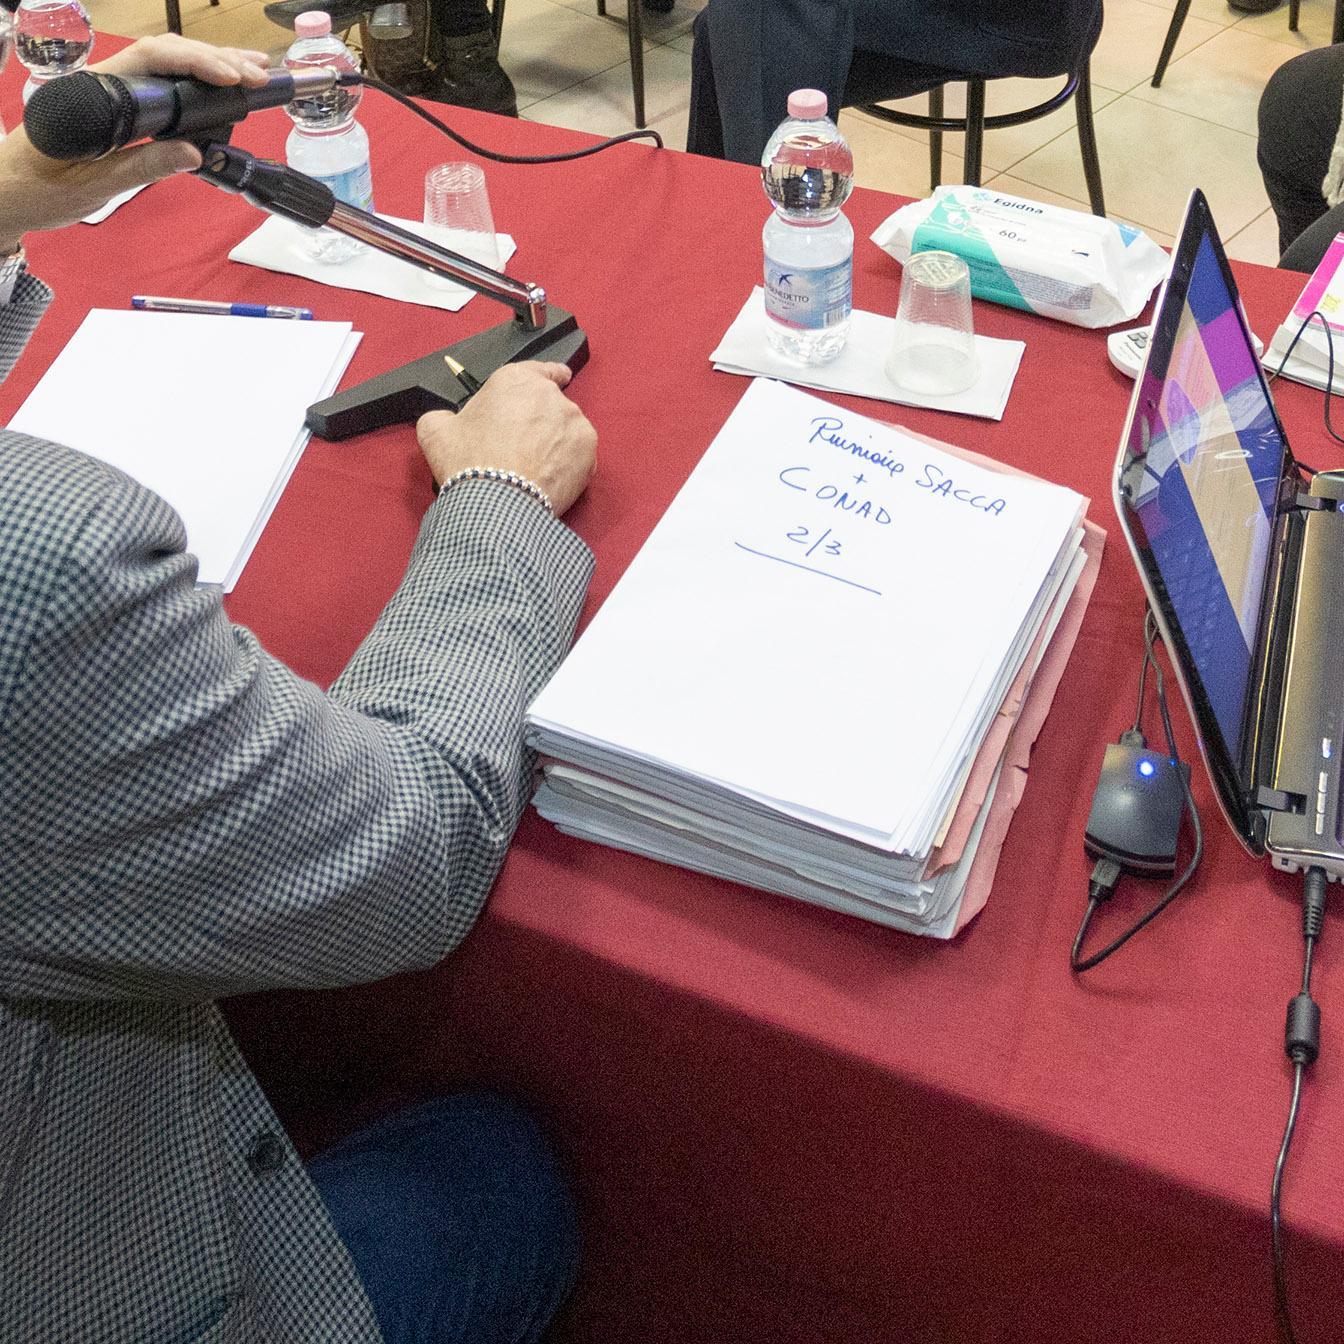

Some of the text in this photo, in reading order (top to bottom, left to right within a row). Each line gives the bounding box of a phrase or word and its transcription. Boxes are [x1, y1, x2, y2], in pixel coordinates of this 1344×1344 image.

[779, 466, 893, 526] CONAD
[915, 464, 1008, 517] SACCA
[786, 525, 842, 557] 2/3
